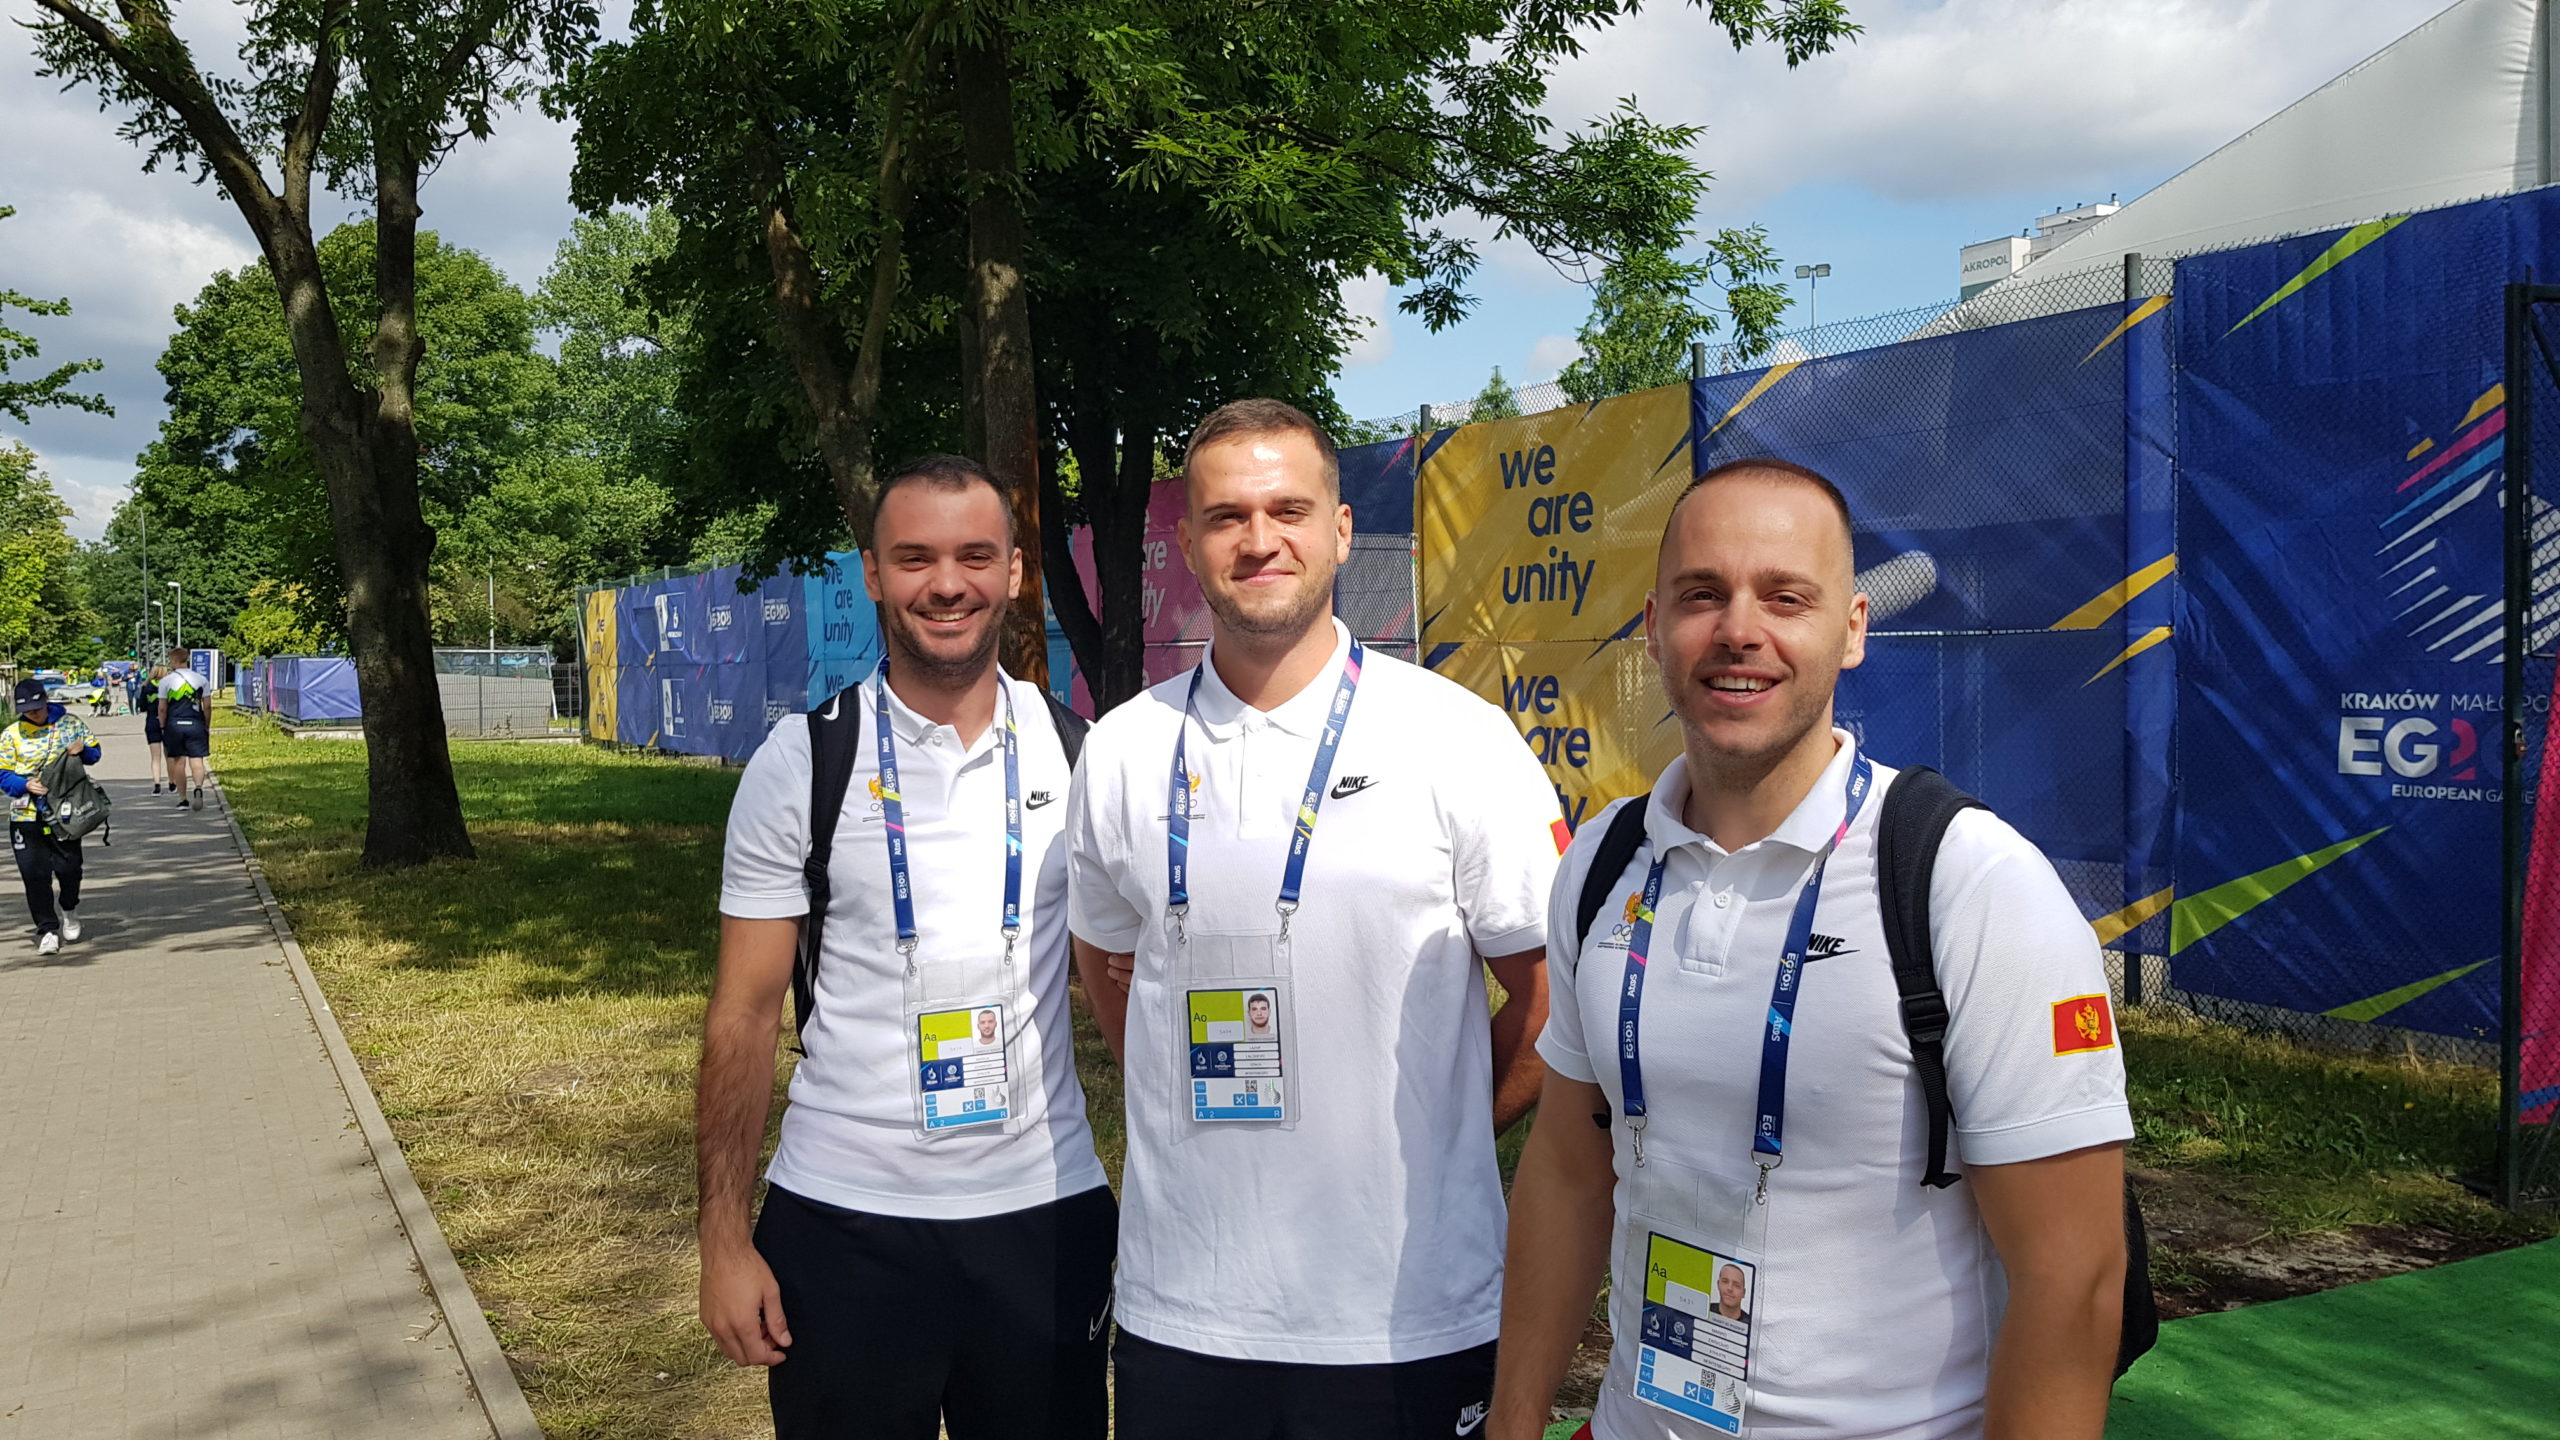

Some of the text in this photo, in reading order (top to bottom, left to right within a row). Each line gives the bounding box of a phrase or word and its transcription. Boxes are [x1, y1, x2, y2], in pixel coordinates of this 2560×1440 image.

[1963, 255, 2008, 273] AKROPOL
[1500, 445, 1556, 489] we
[1528, 491, 1594, 537] are
[1502, 546, 1596, 616] unity
[835, 588, 853, 610] are
[824, 615, 855, 648] unity
[1502, 674, 1559, 714] we
[2341, 689, 2440, 711] KRAKÓW
[1525, 725, 1591, 768] are
[1338, 775, 1368, 789] NIKE
[2392, 784, 2482, 801] EUROPEAN
[1030, 790, 1050, 801] NIKE
[1808, 933, 1845, 954] NIKE
[924, 1033, 937, 1042] Aa
[1651, 1262, 1667, 1278] Aa
[1461, 1401, 1483, 1424] NIKE
[1640, 1387, 1737, 1431] A 2 R
